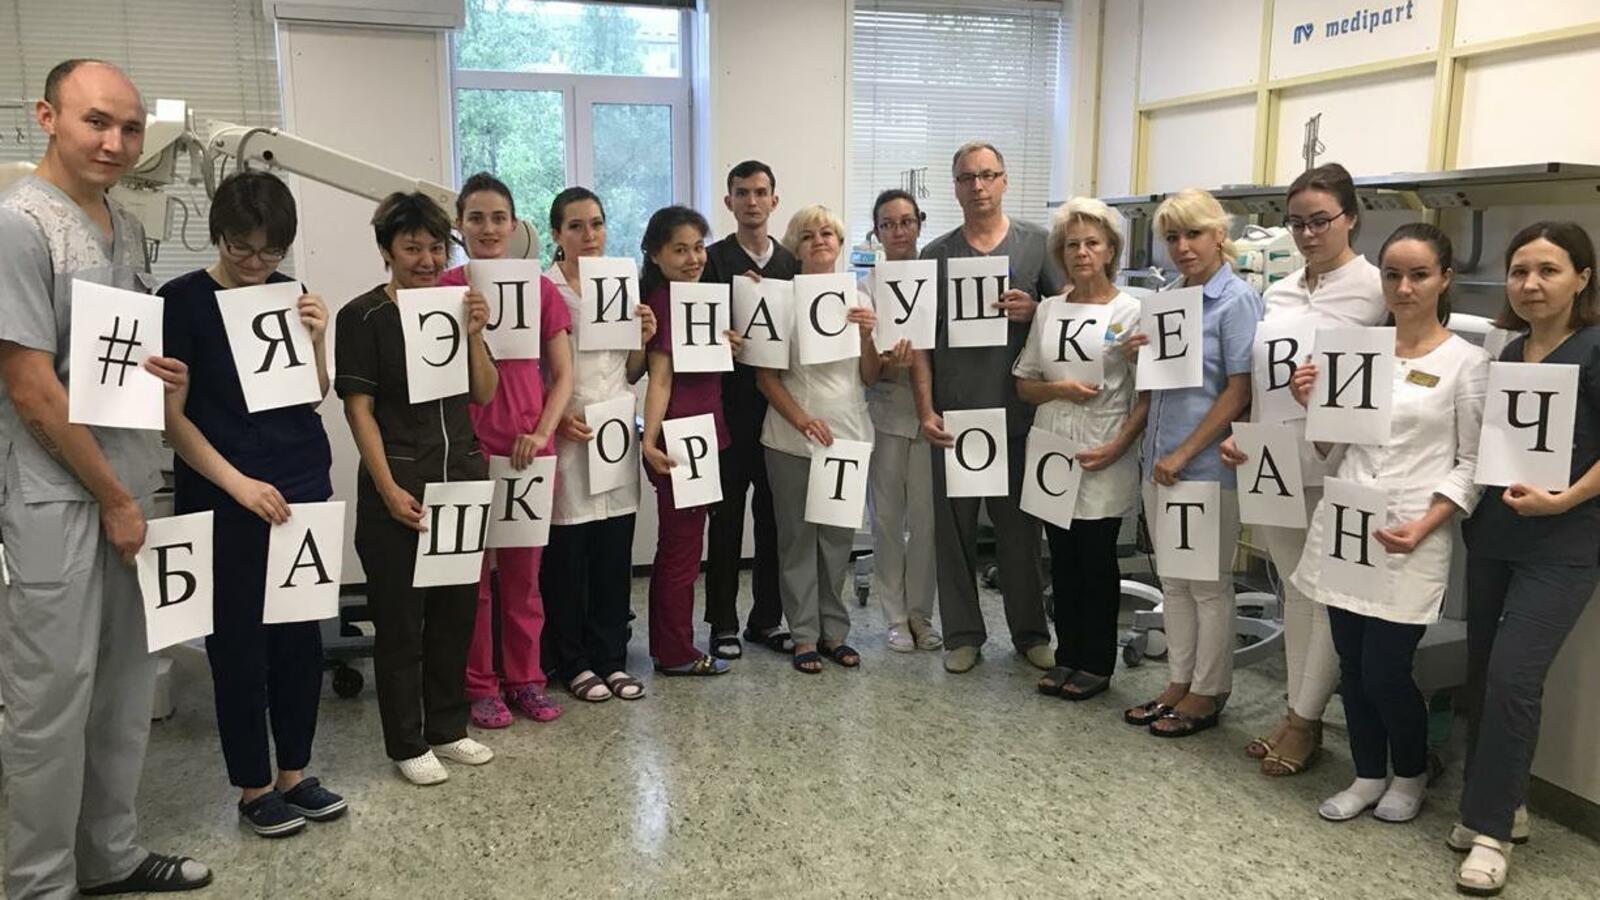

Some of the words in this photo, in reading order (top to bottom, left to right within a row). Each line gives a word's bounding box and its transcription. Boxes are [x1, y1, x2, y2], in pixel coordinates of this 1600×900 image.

[1325, 0, 1413, 38] medipart
[486, 281, 531, 331] Л
[590, 277, 633, 324] И
[742, 297, 782, 342] А
[809, 290, 849, 337] С
[885, 278, 928, 325] У
[951, 275, 1007, 321] Ш
[251, 309, 306, 375] Я
[419, 311, 460, 367] Э
[681, 302, 722, 346] Н
[1053, 319, 1096, 362] К
[1154, 309, 1188, 361] Е
[1265, 338, 1299, 392] В
[1320, 351, 1381, 410] И
[597, 419, 630, 463] О
[1502, 390, 1559, 452] Ч
[682, 436, 708, 480] Р
[955, 428, 996, 471] О
[1248, 445, 1294, 498] А
[824, 457, 858, 500] Т
[1037, 452, 1073, 496] С
[497, 477, 544, 522] К
[423, 504, 490, 556] Ш
[1166, 502, 1204, 550] Т
[1330, 503, 1375, 567] Н
[150, 542, 196, 609] Б
[280, 528, 333, 588] А
